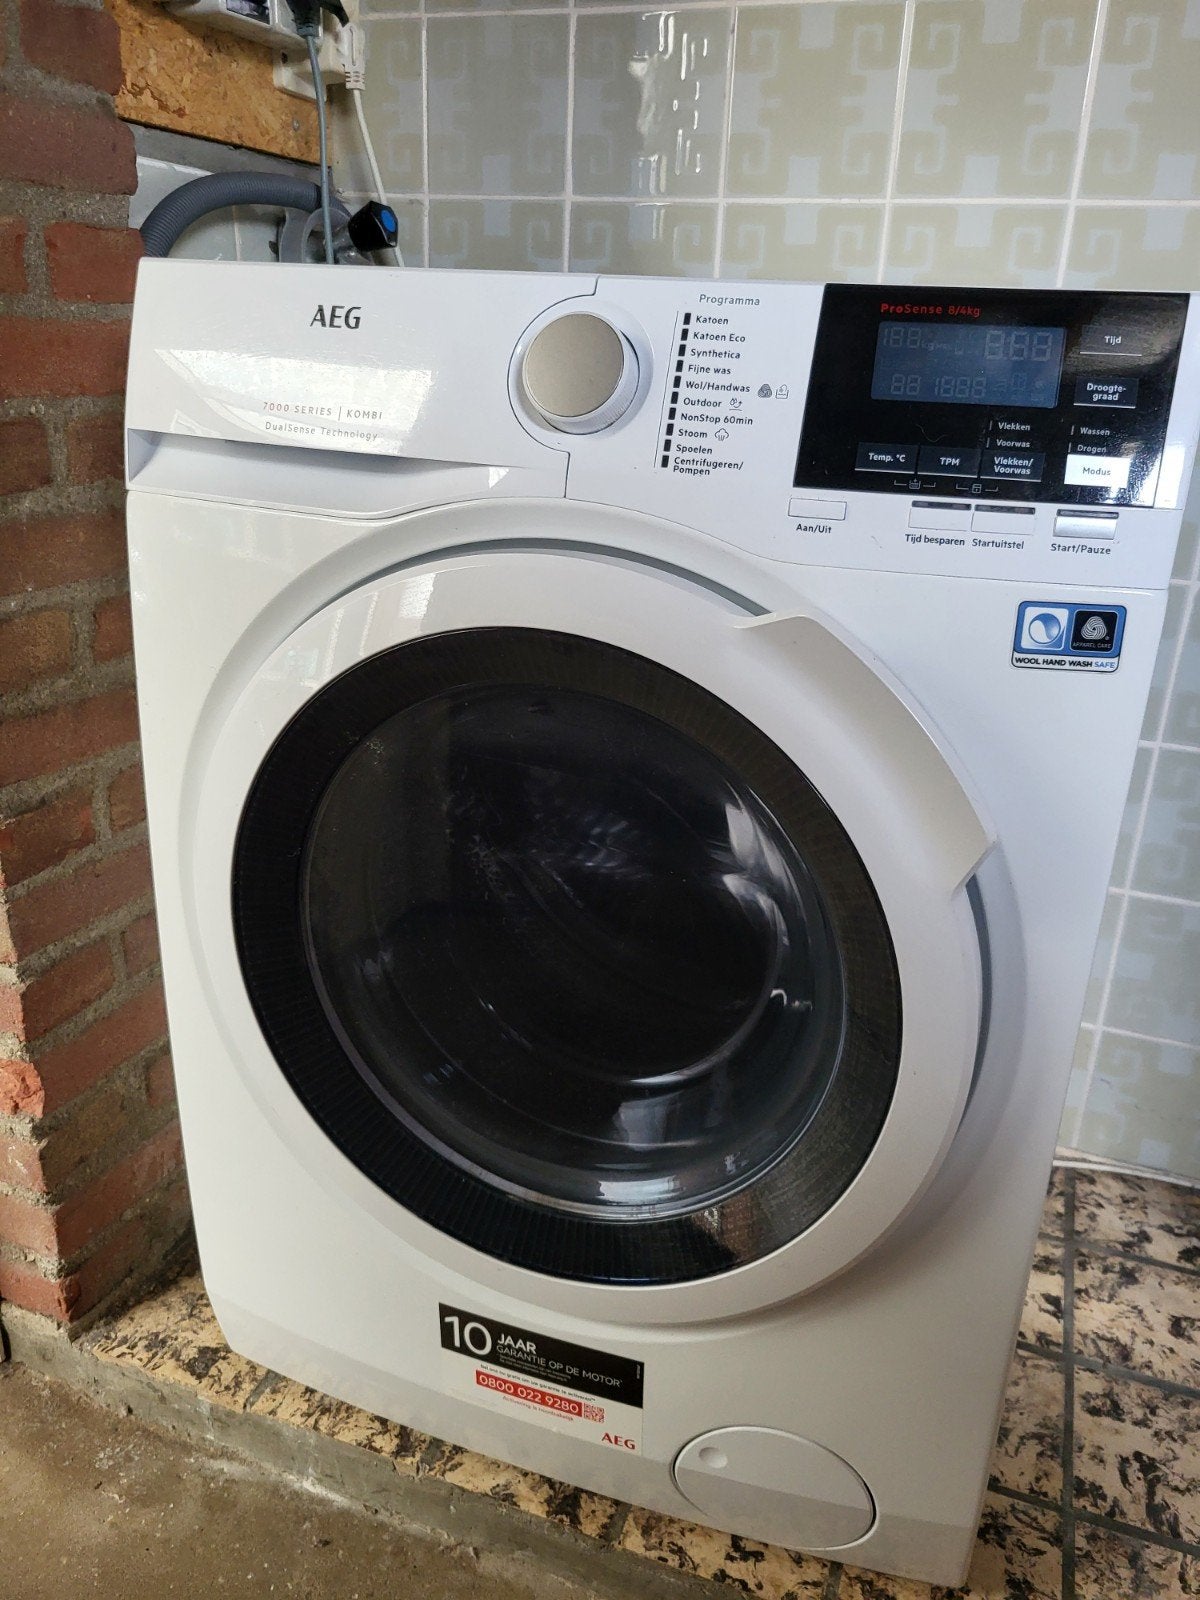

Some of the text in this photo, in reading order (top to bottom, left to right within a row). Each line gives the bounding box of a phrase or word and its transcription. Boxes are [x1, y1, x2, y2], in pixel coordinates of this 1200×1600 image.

[699, 294, 760, 306] Programma
[881, 303, 981, 317] ProSense 8/4kg
[310, 304, 362, 329] AEG
[696, 315, 729, 325] Katoen
[693, 332, 746, 342] Katoen Eco
[1104, 336, 1122, 345] Tijd
[690, 349, 741, 359] Synthetica
[688, 365, 711, 375] Fijne
[686, 380, 750, 392] Wol/Handwas
[1086, 382, 1126, 393] Droogte-
[1092, 392, 1119, 401] graad
[683, 397, 722, 408] Outdoor
[263, 402, 383, 419] 7000 SERIES KOMBI
[681, 413, 753, 425] NonStop 60min
[265, 422, 377, 442] DualSense Technology
[998, 422, 1031, 431] Vlekken
[1080, 427, 1110, 436] Wassen
[678, 429, 708, 439] Stoom
[996, 439, 1030, 448] Voorwas
[1077, 444, 1107, 454] Drogen
[676, 444, 713, 455] Spoelen
[868, 453, 906, 462] Temp. °C
[940, 457, 960, 466] TPM
[994, 457, 1034, 467] Vlekken/
[674, 457, 744, 470] Centrifugeren/
[673, 465, 710, 476] Pompen
[994, 465, 1031, 475] Voorwas
[1082, 467, 1111, 476] Modus
[796, 524, 832, 534] Aan/Uit
[905, 534, 965, 546] Tijd besparen
[972, 538, 1024, 550] Startuitstel
[1050, 543, 1111, 555] Start/Pauze
[1014, 657, 1040, 665] WOOL
[1042, 658, 1066, 666] HAND
[1094, 661, 1116, 669] SAFE
[444, 1316, 492, 1356] 10
[497, 1333, 537, 1355] JAAR
[496, 1345, 546, 1366] GARANTIE
[548, 1360, 563, 1370] OP
[565, 1365, 580, 1376] DE
[479, 1374, 514, 1393] 0800
[517, 1387, 542, 1403] 022
[545, 1395, 579, 1413] 9280
[601, 1432, 635, 1450] AEG
